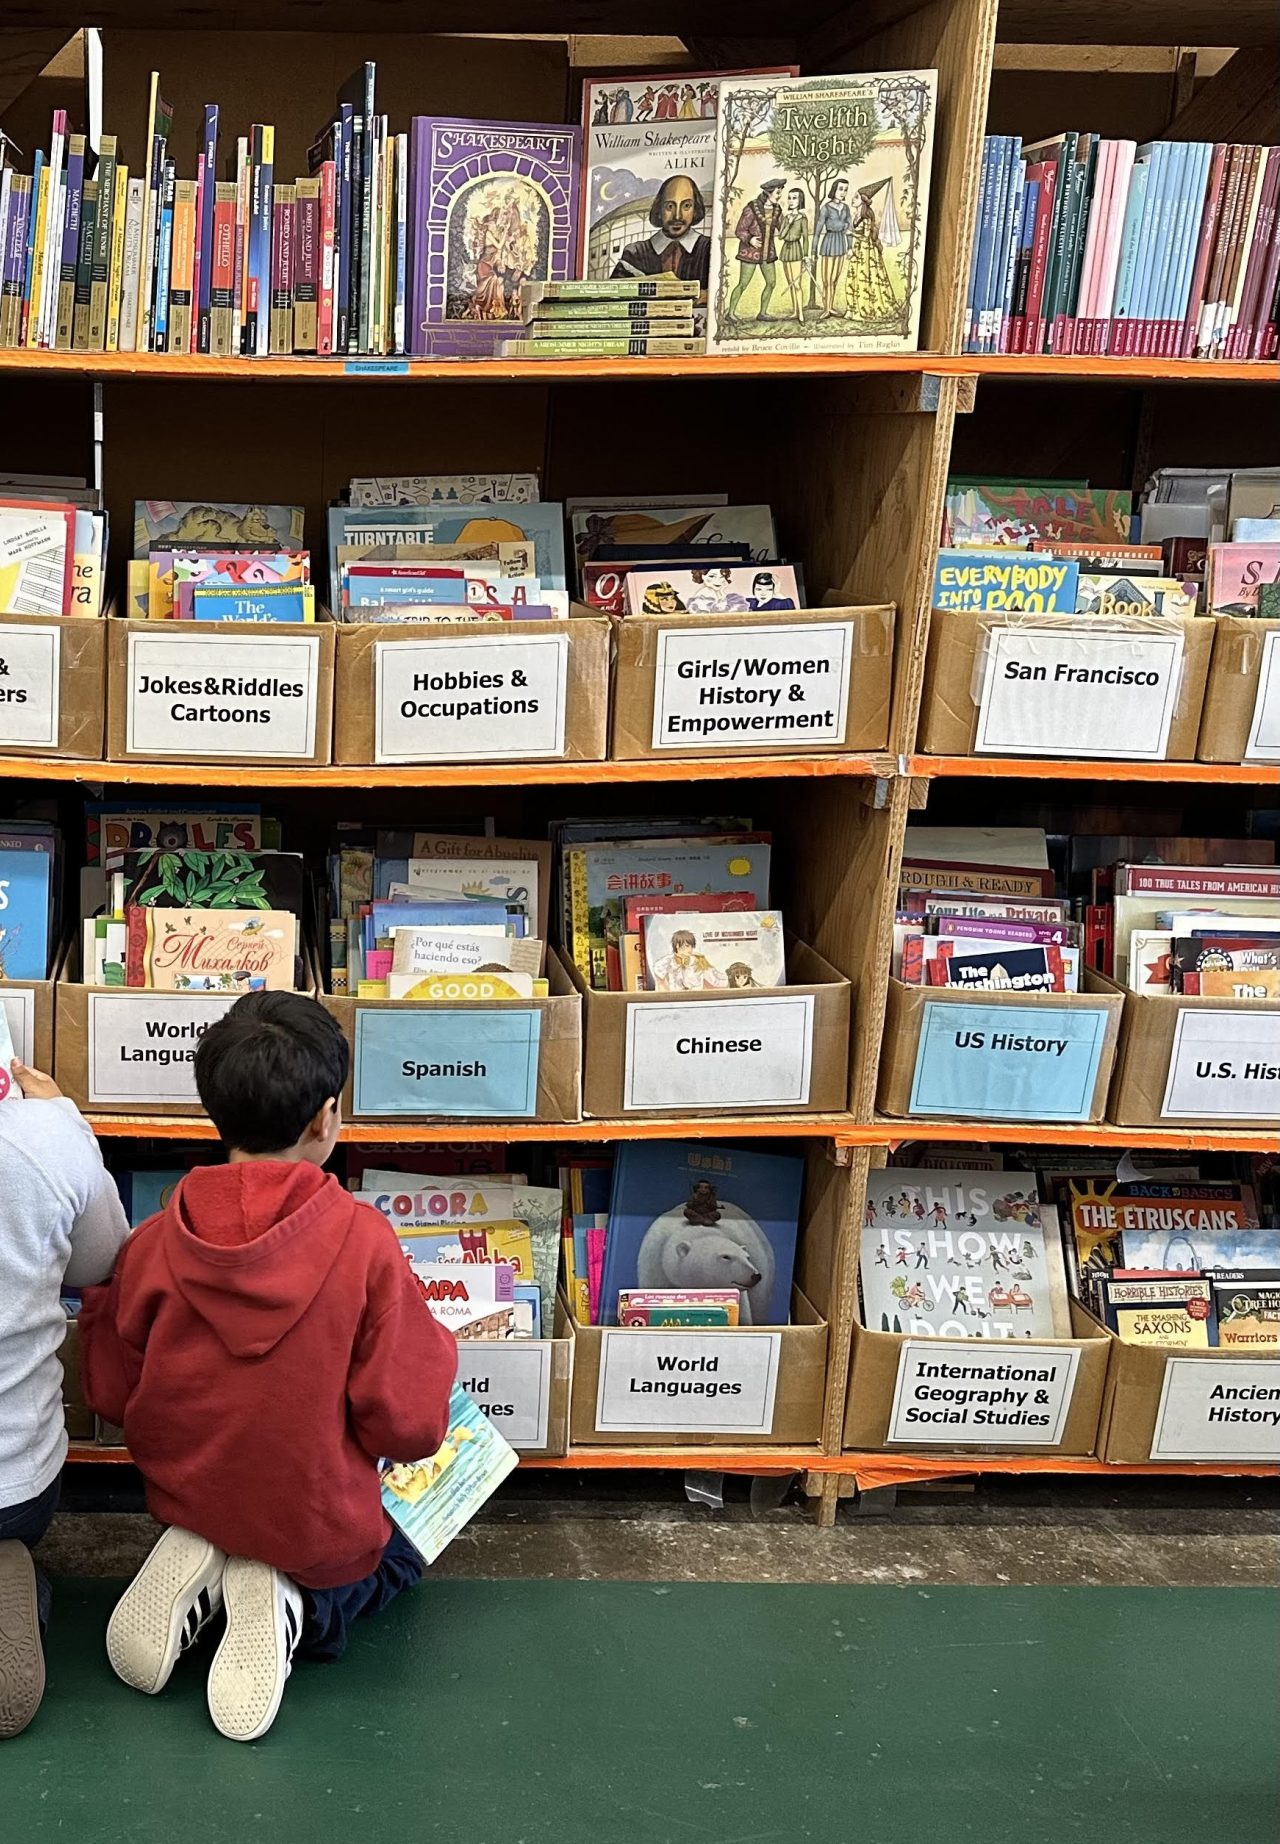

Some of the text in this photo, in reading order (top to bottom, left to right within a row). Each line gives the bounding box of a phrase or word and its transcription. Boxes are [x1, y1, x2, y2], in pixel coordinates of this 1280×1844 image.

[783, 89, 873, 101] WILLIAM SHAKESPEARE'S
[780, 107, 869, 131] Twelfth
[438, 130, 565, 164] SHAKESPEARE
[595, 130, 711, 149] William Shakespeare
[790, 135, 856, 161] Night
[664, 157, 705, 170] ALIKI
[69, 189, 80, 230] MACBETH
[100, 161, 112, 257] THE MERCHANT OF VENICE
[84, 221, 94, 265] MACBETH
[221, 224, 230, 267] OTHELLO
[344, 531, 433, 545] TURNTABLE
[940, 564, 1068, 591] EVERYBODY
[234, 601, 265, 614] The
[677, 657, 830, 680] Girls/Women
[1004, 661, 1159, 686] San Francisco
[139, 676, 304, 697] Jokes&Riddles
[413, 669, 529, 692] Hobbies &
[699, 684, 806, 706] History &
[171, 704, 271, 723] Cartoons
[400, 697, 539, 720] Occupations
[668, 709, 834, 736] Empowerment
[901, 871, 1034, 893] ROUGH & READY
[1139, 878, 1269, 894] 100 TRUE TALES FROM AMERICAN
[436, 938, 454, 950] qué
[456, 941, 480, 952] estás
[1052, 931, 1063, 944] 4
[154, 932, 274, 972] Михалков
[414, 950, 482, 965] haciendo eso?
[1240, 952, 1277, 966] What's
[945, 972, 1055, 990] Washington
[959, 966, 988, 979] The
[429, 984, 494, 997] GOOD
[676, 1037, 762, 1055] Chinese
[955, 1031, 1068, 1056] US History
[121, 1046, 197, 1065] Langua
[402, 1060, 487, 1080] Spanish
[1196, 1062, 1236, 1078] U.S.
[374, 1192, 489, 1217] COLORA
[1080, 1204, 1239, 1231] THE ETRUSCANS
[927, 1231, 1021, 1260] HOW
[926, 1275, 985, 1305] WE
[1114, 1286, 1204, 1299] HORRIBLE HISTORIES
[440, 1307, 471, 1315] ROMA
[1134, 1321, 1191, 1334] SAXONS
[1225, 1333, 1277, 1343] Warriors
[657, 1356, 719, 1372] World
[915, 1362, 1057, 1382] International
[629, 1377, 742, 1398] Languages
[914, 1384, 1050, 1407] Geography &
[1210, 1385, 1280, 1400] Ancien
[905, 1407, 1050, 1426] Social Studies
